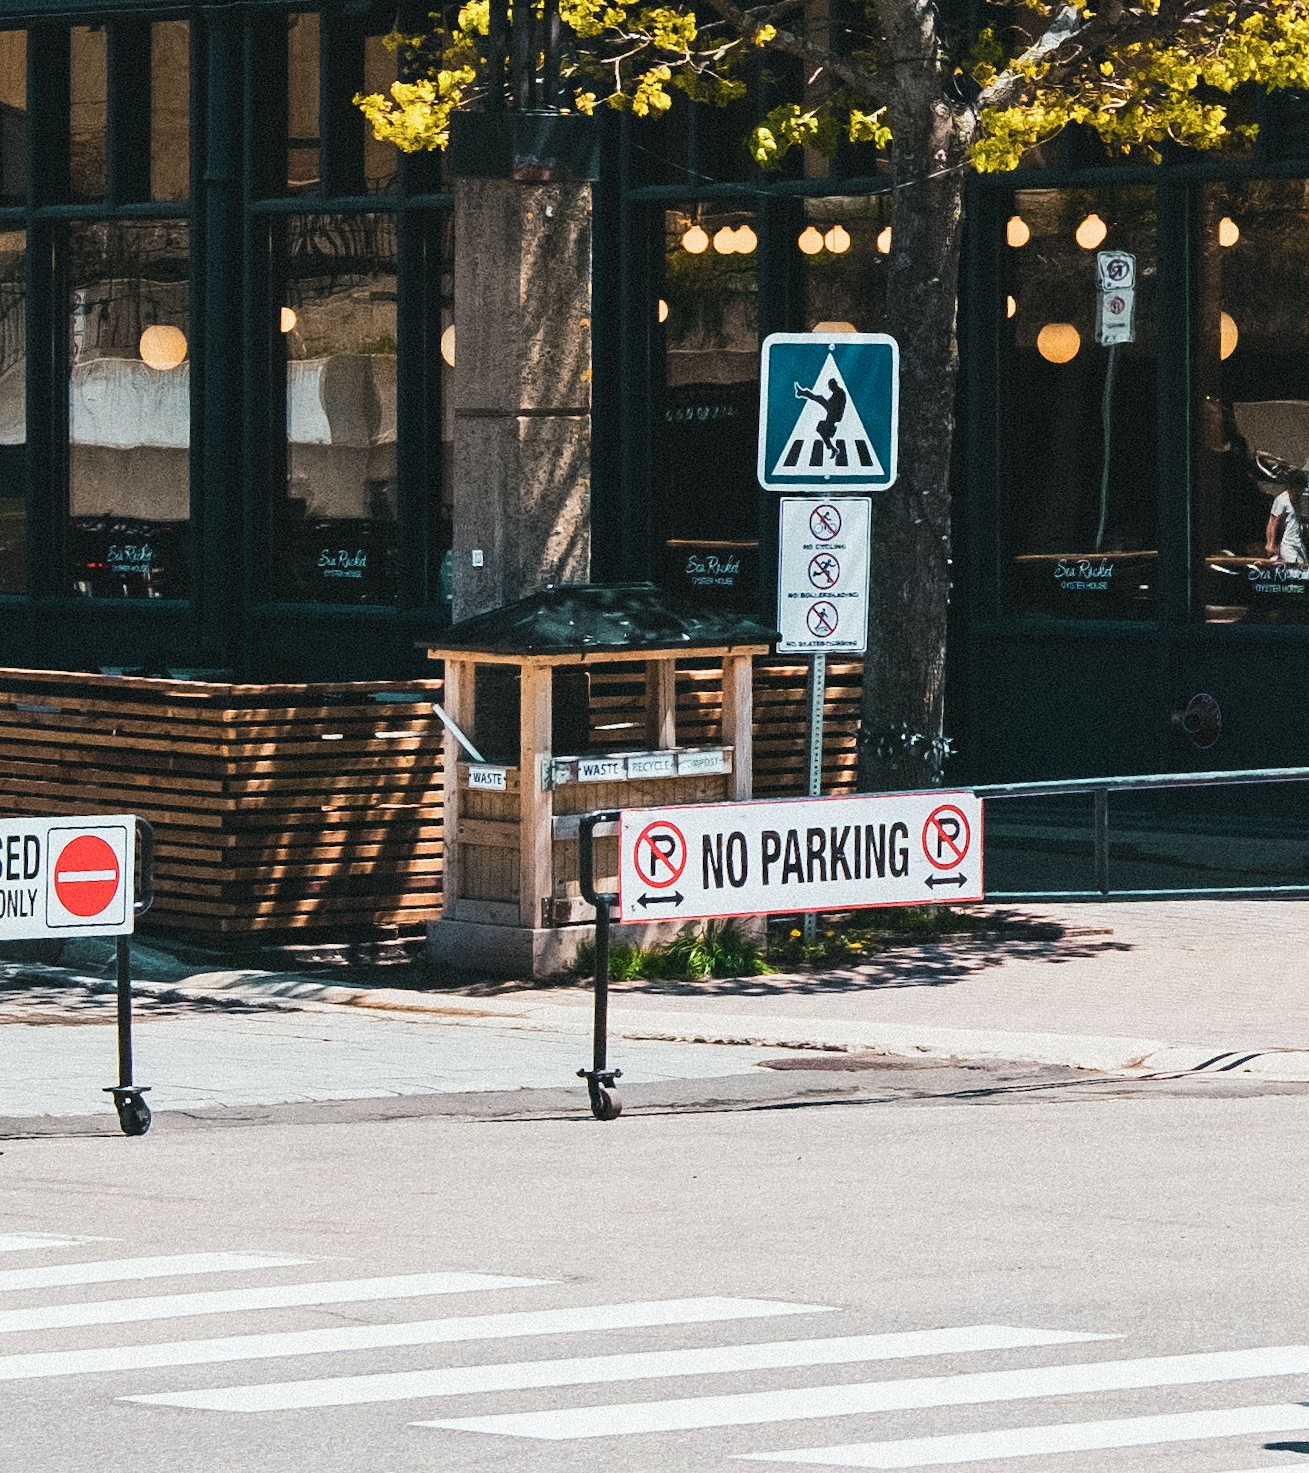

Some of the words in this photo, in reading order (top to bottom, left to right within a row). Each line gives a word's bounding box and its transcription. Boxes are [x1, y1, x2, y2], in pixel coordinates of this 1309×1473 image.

[473, 772, 502, 785] WASTE
[702, 831, 748, 890] NO
[761, 821, 910, 886] PARKING
